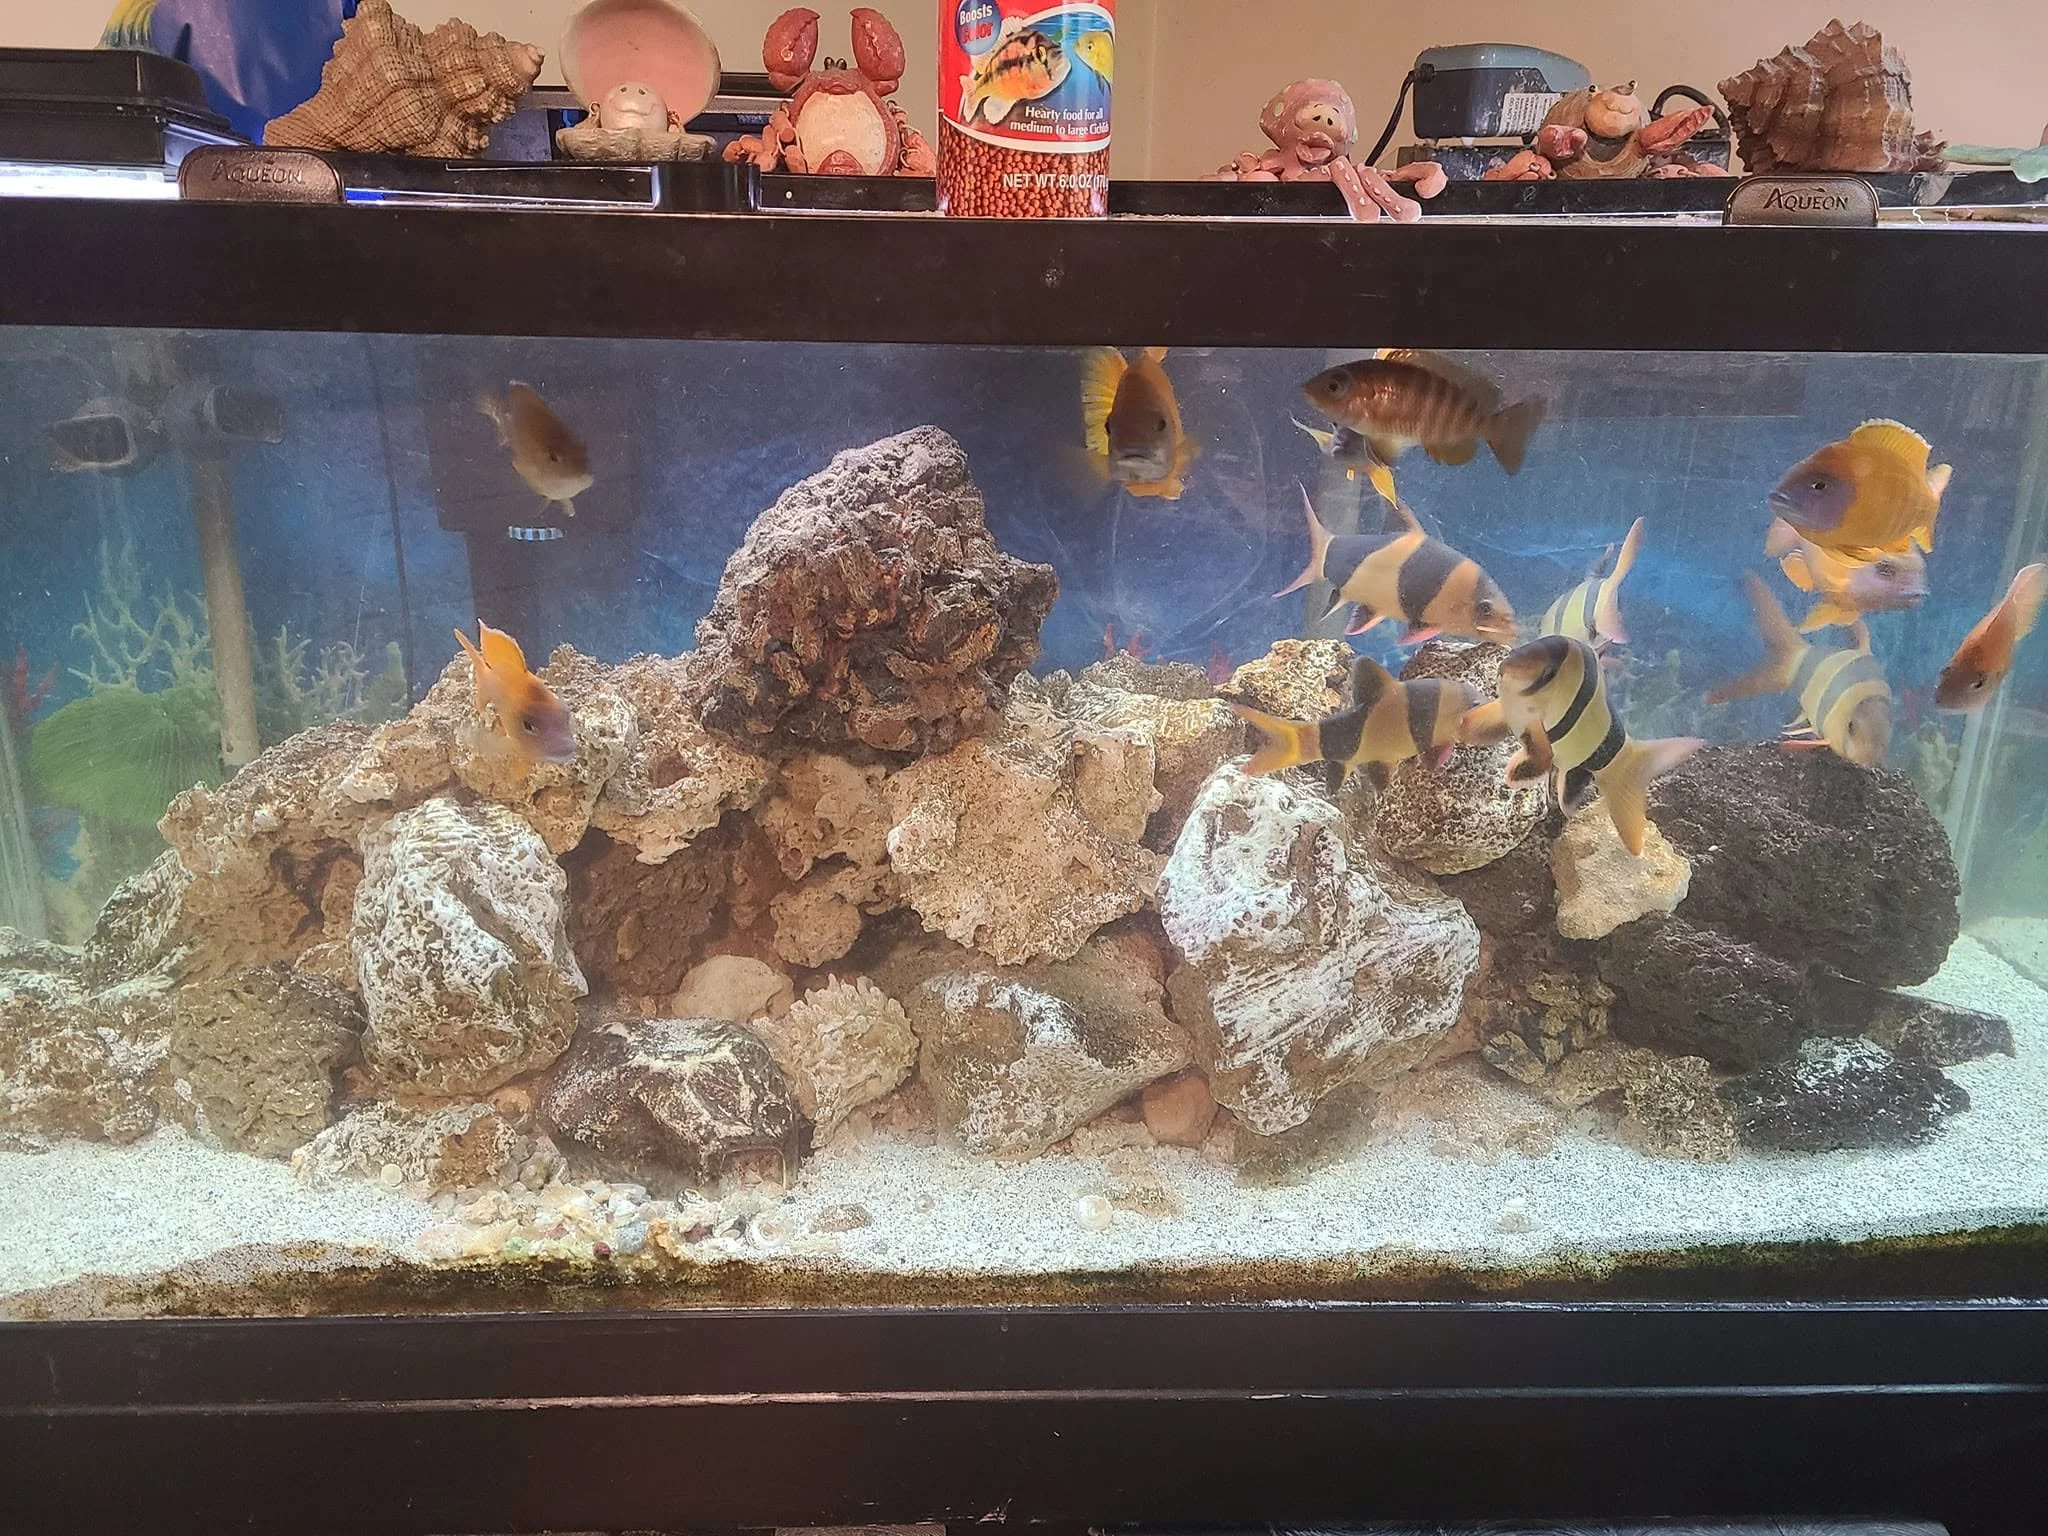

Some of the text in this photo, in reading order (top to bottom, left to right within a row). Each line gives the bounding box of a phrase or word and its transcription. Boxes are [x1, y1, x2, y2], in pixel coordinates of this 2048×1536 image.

[960, 4, 992, 25] Boosts
[1025, 106, 1060, 123] Hearty
[1063, 108, 1083, 120] food
[1084, 108, 1095, 120] for
[1010, 121, 1053, 134] medium
[1056, 124, 1066, 134] to
[1068, 124, 1088, 138] large
[1003, 173, 1032, 188] NET
[1035, 173, 1056, 188] WT
[1059, 173, 1076, 188] 6.0
[1078, 173, 1092, 188] OZ
[1763, 187, 1848, 212] AQUEON
